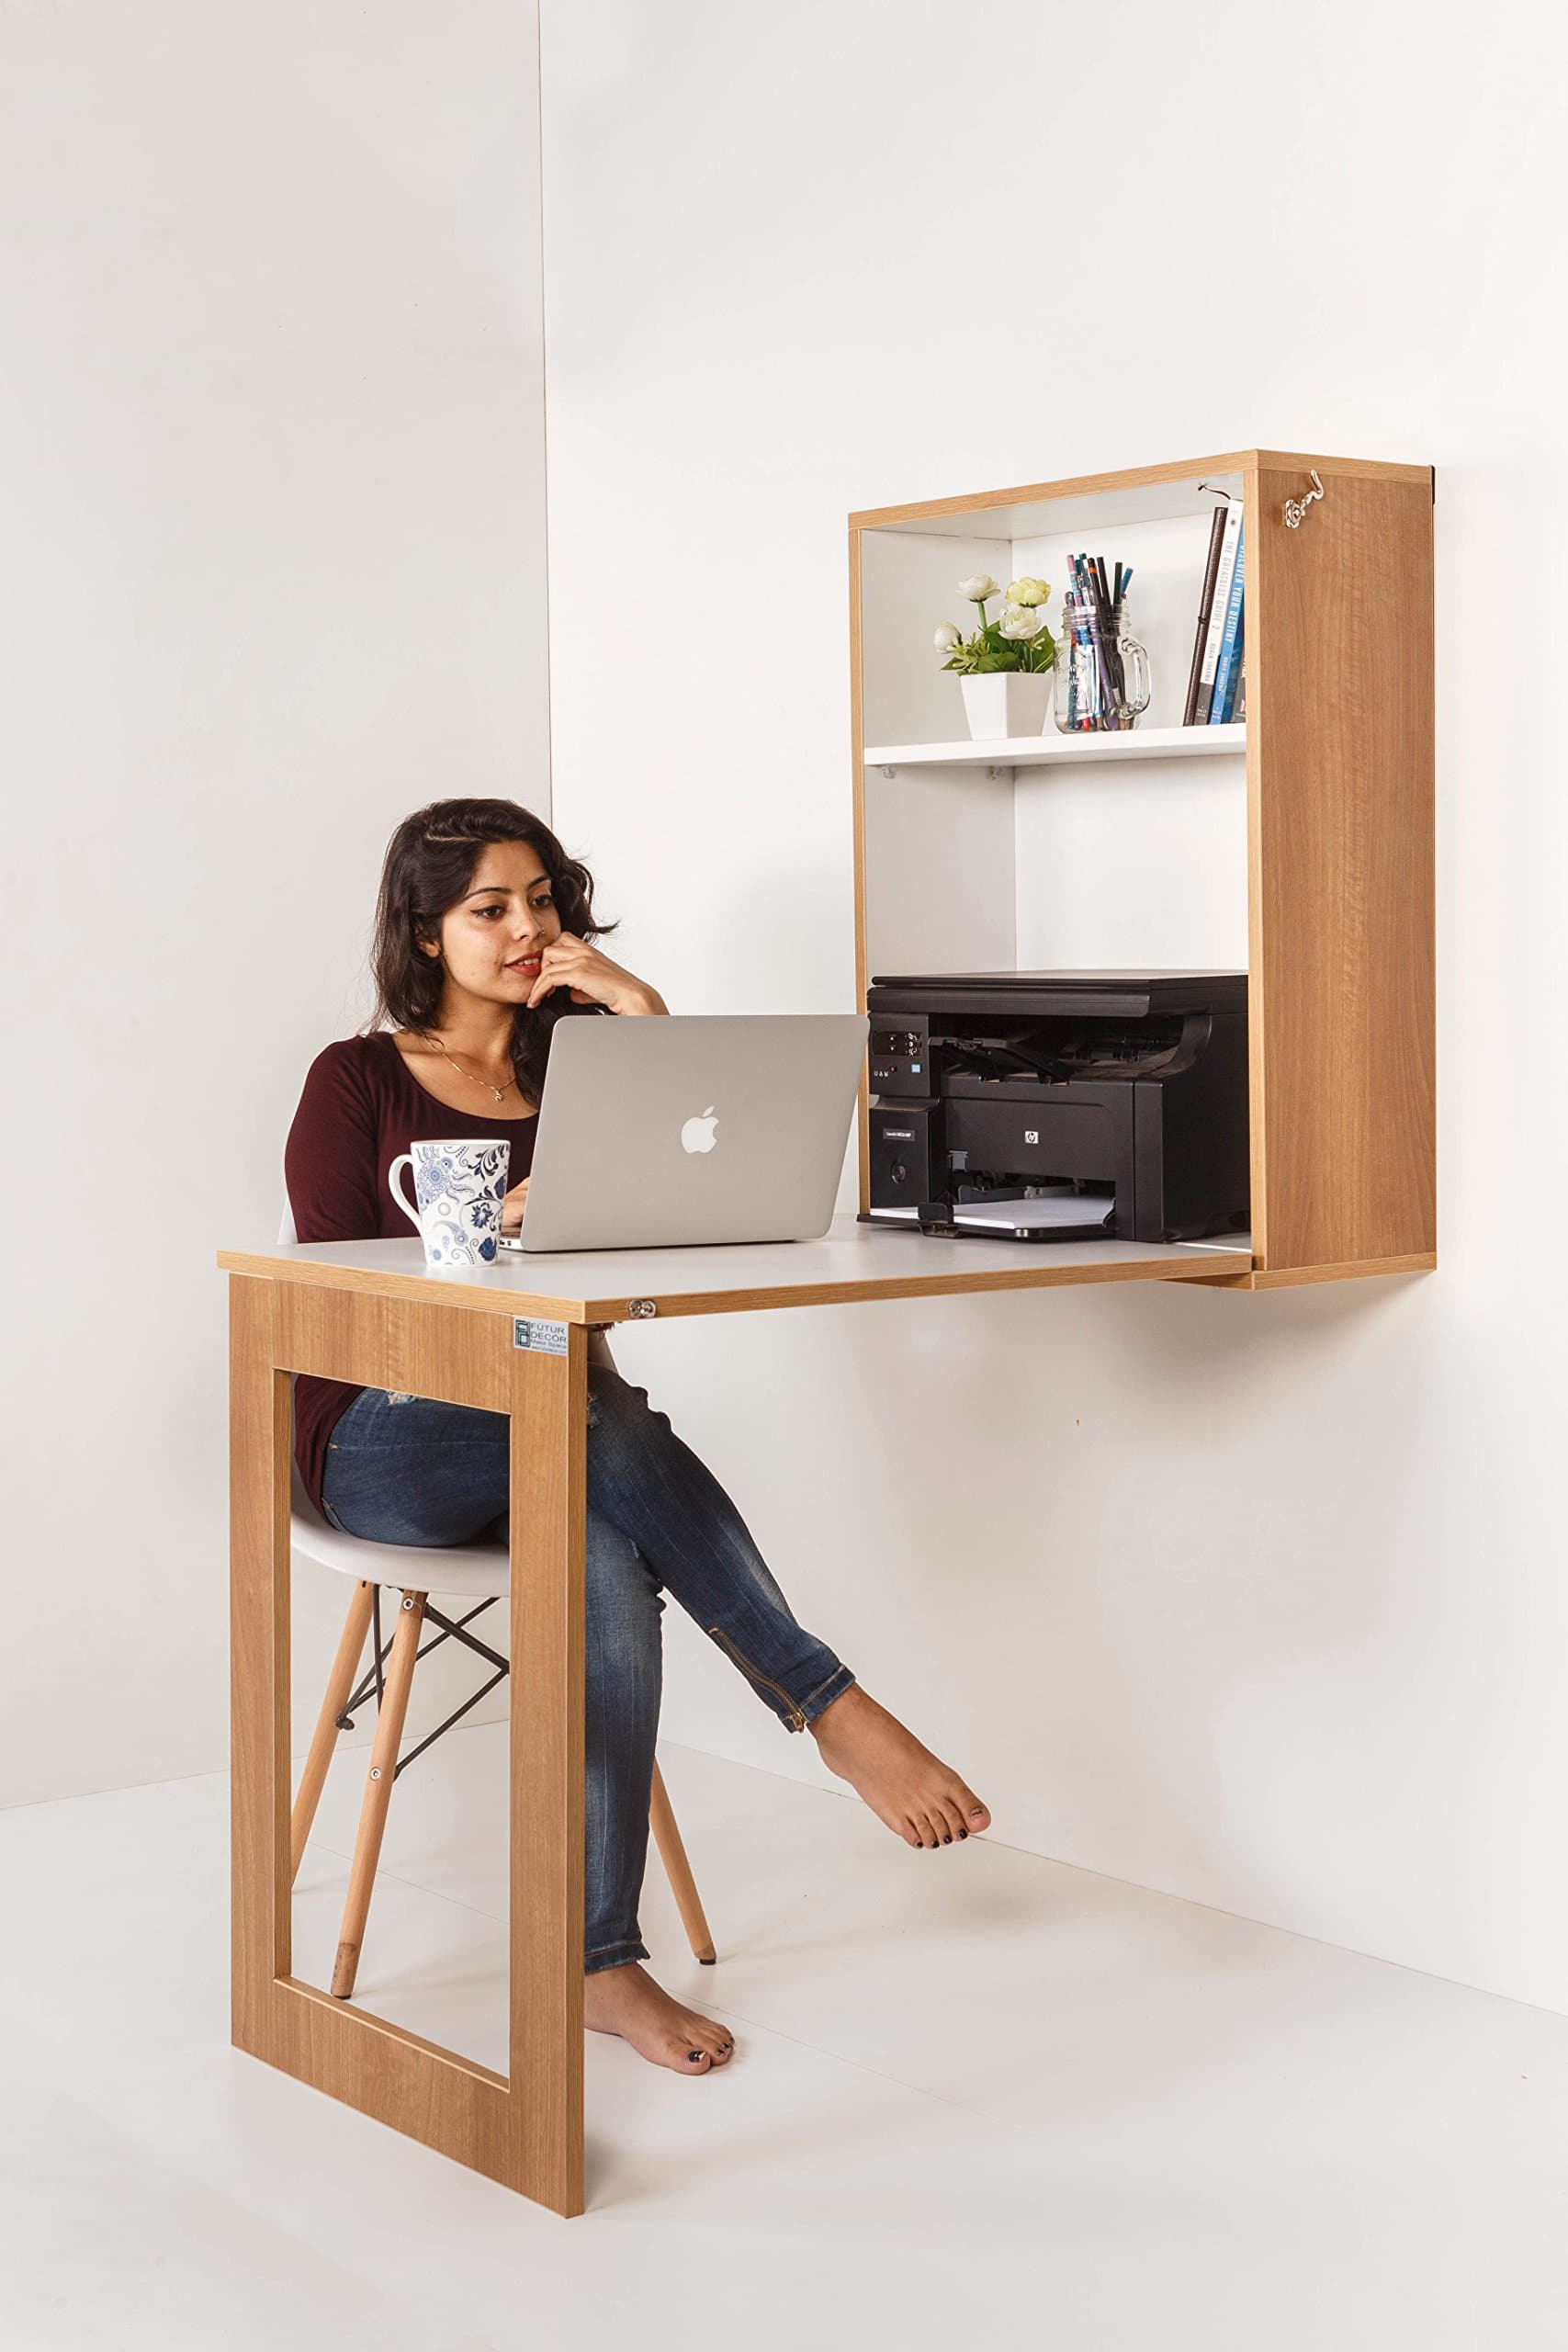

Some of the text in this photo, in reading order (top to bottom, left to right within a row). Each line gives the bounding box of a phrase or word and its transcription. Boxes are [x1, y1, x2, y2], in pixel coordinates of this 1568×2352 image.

[1218, 558, 1231, 596] GREATNESS
[1231, 587, 1243, 607] YOUR
[1213, 600, 1224, 621] GUIDE
[1224, 610, 1237, 642] DESTINY
